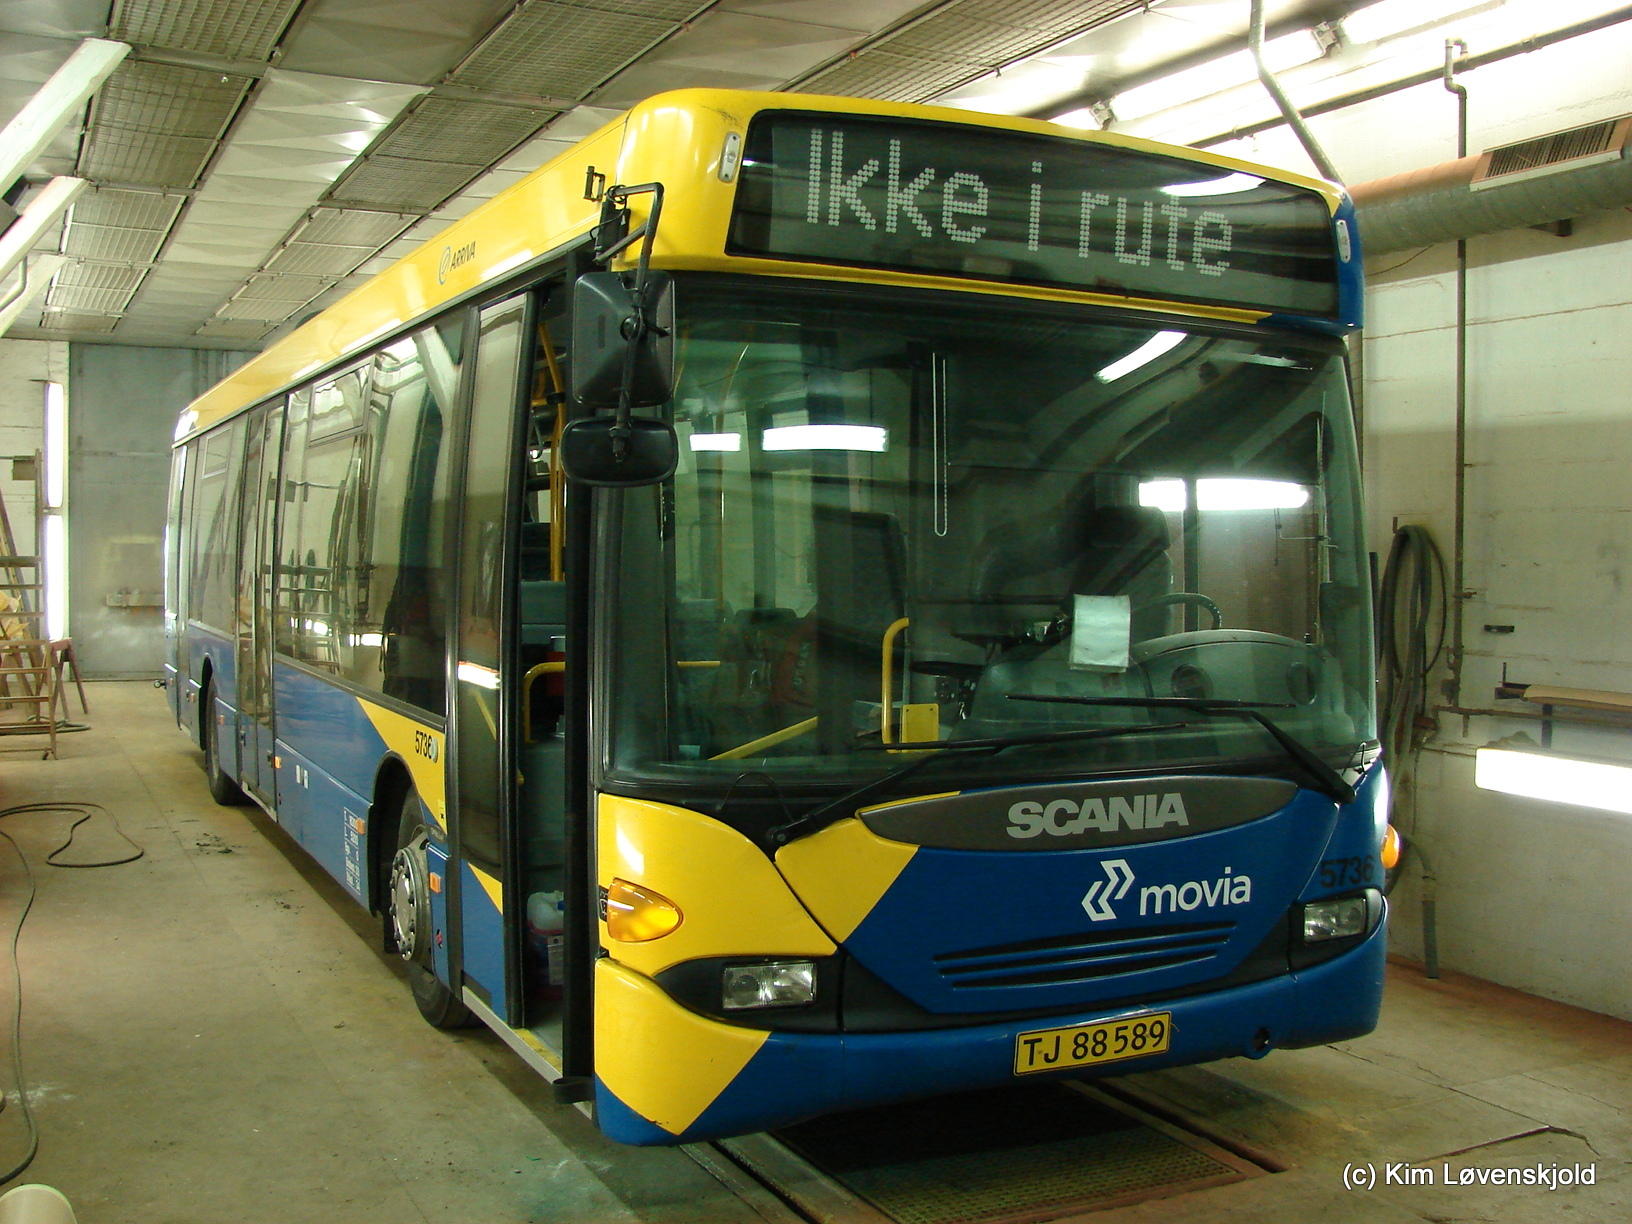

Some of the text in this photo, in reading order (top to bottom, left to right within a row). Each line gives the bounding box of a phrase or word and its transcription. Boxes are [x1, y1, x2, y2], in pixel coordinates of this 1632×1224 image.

[807, 128, 1233, 277] Ikke i rute
[1006, 792, 1190, 839] SCANIA
[1139, 866, 1252, 917] movia
[1320, 855, 1375, 889] 5736
[1023, 1035, 1061, 1066] TJ
